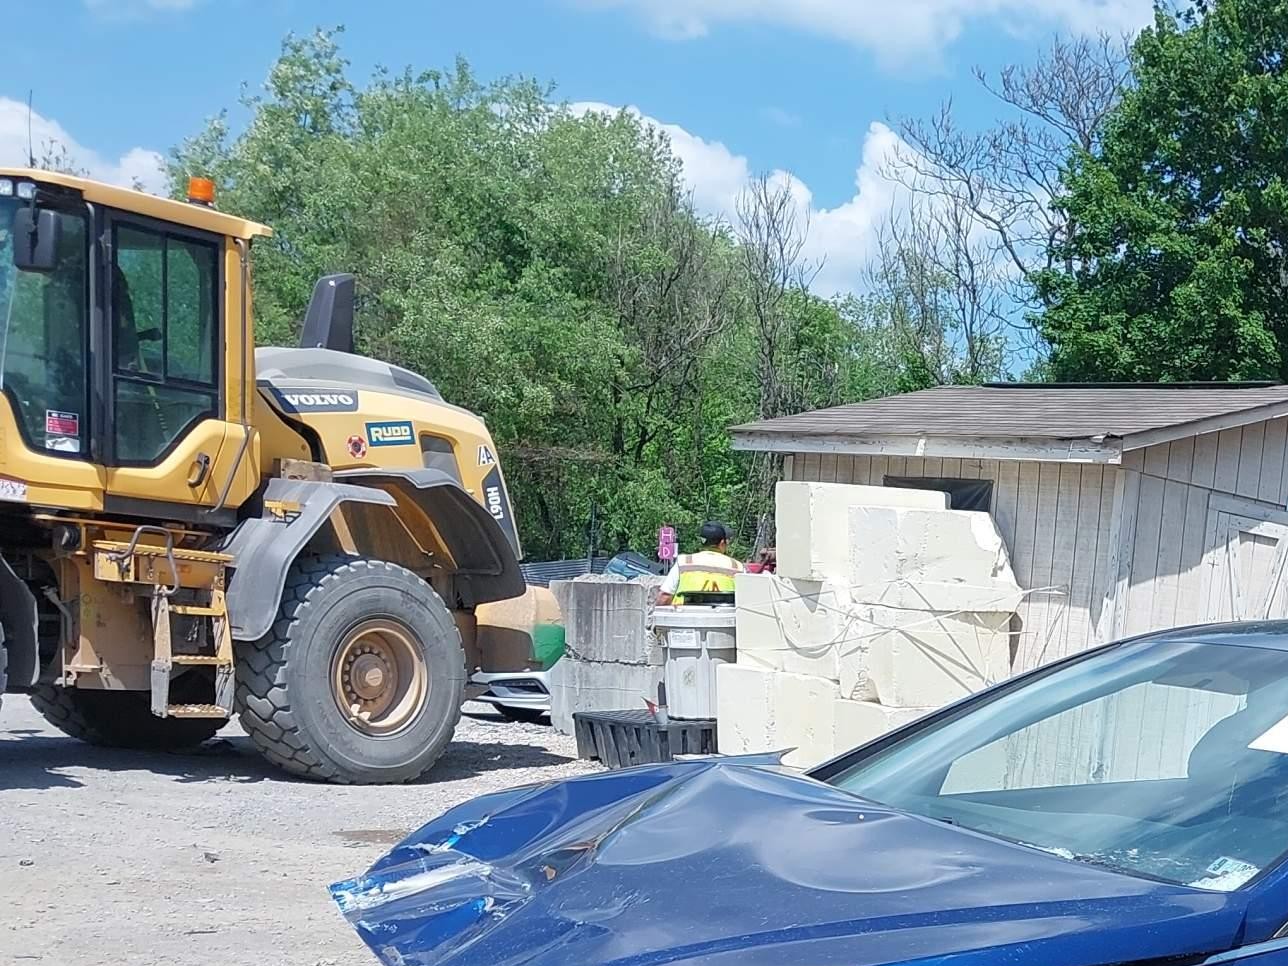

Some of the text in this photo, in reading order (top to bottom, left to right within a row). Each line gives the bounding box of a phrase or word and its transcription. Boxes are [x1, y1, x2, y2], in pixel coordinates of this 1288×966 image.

[282, 393, 354, 406] VOLVO
[370, 425, 412, 442] RUDD
[486, 486, 504, 520] L90H
[661, 529, 673, 540] H
[662, 546, 671, 557] D
